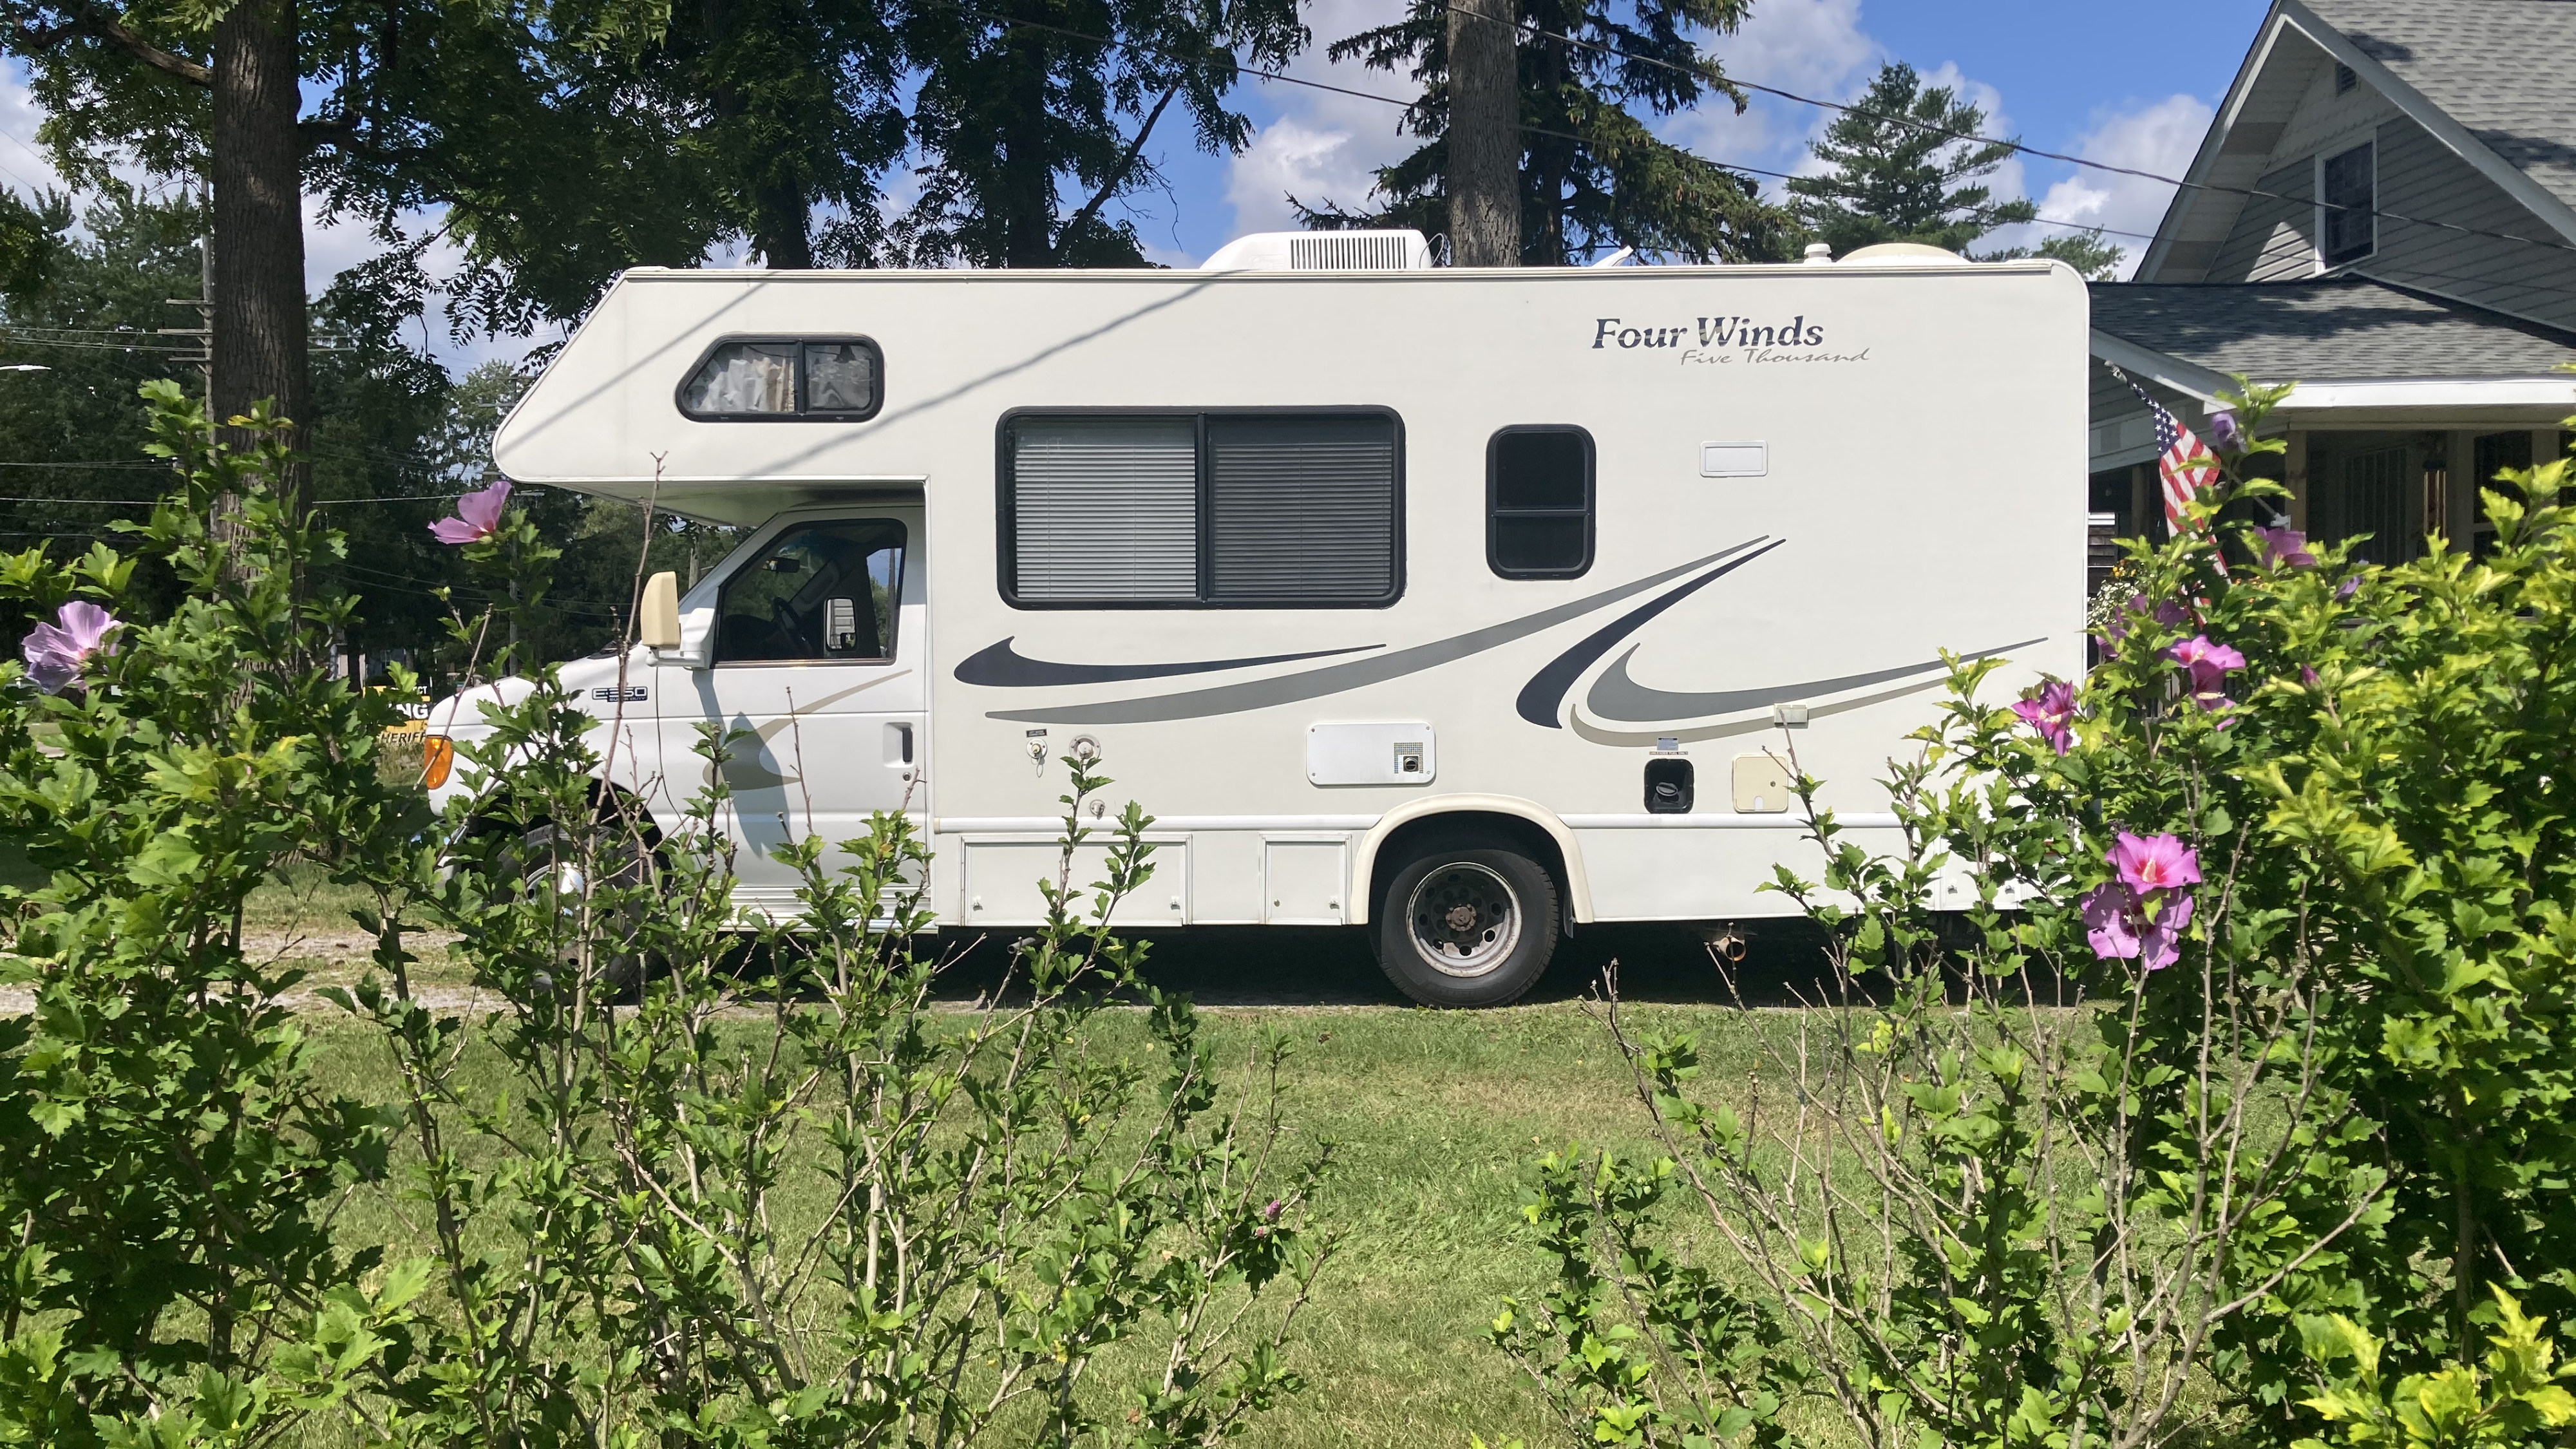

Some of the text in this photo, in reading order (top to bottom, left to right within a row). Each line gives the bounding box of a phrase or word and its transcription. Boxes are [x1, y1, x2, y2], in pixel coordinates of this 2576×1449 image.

[1591, 315, 1824, 349] Four Winds
[1680, 347, 1870, 366] Five Thousand
